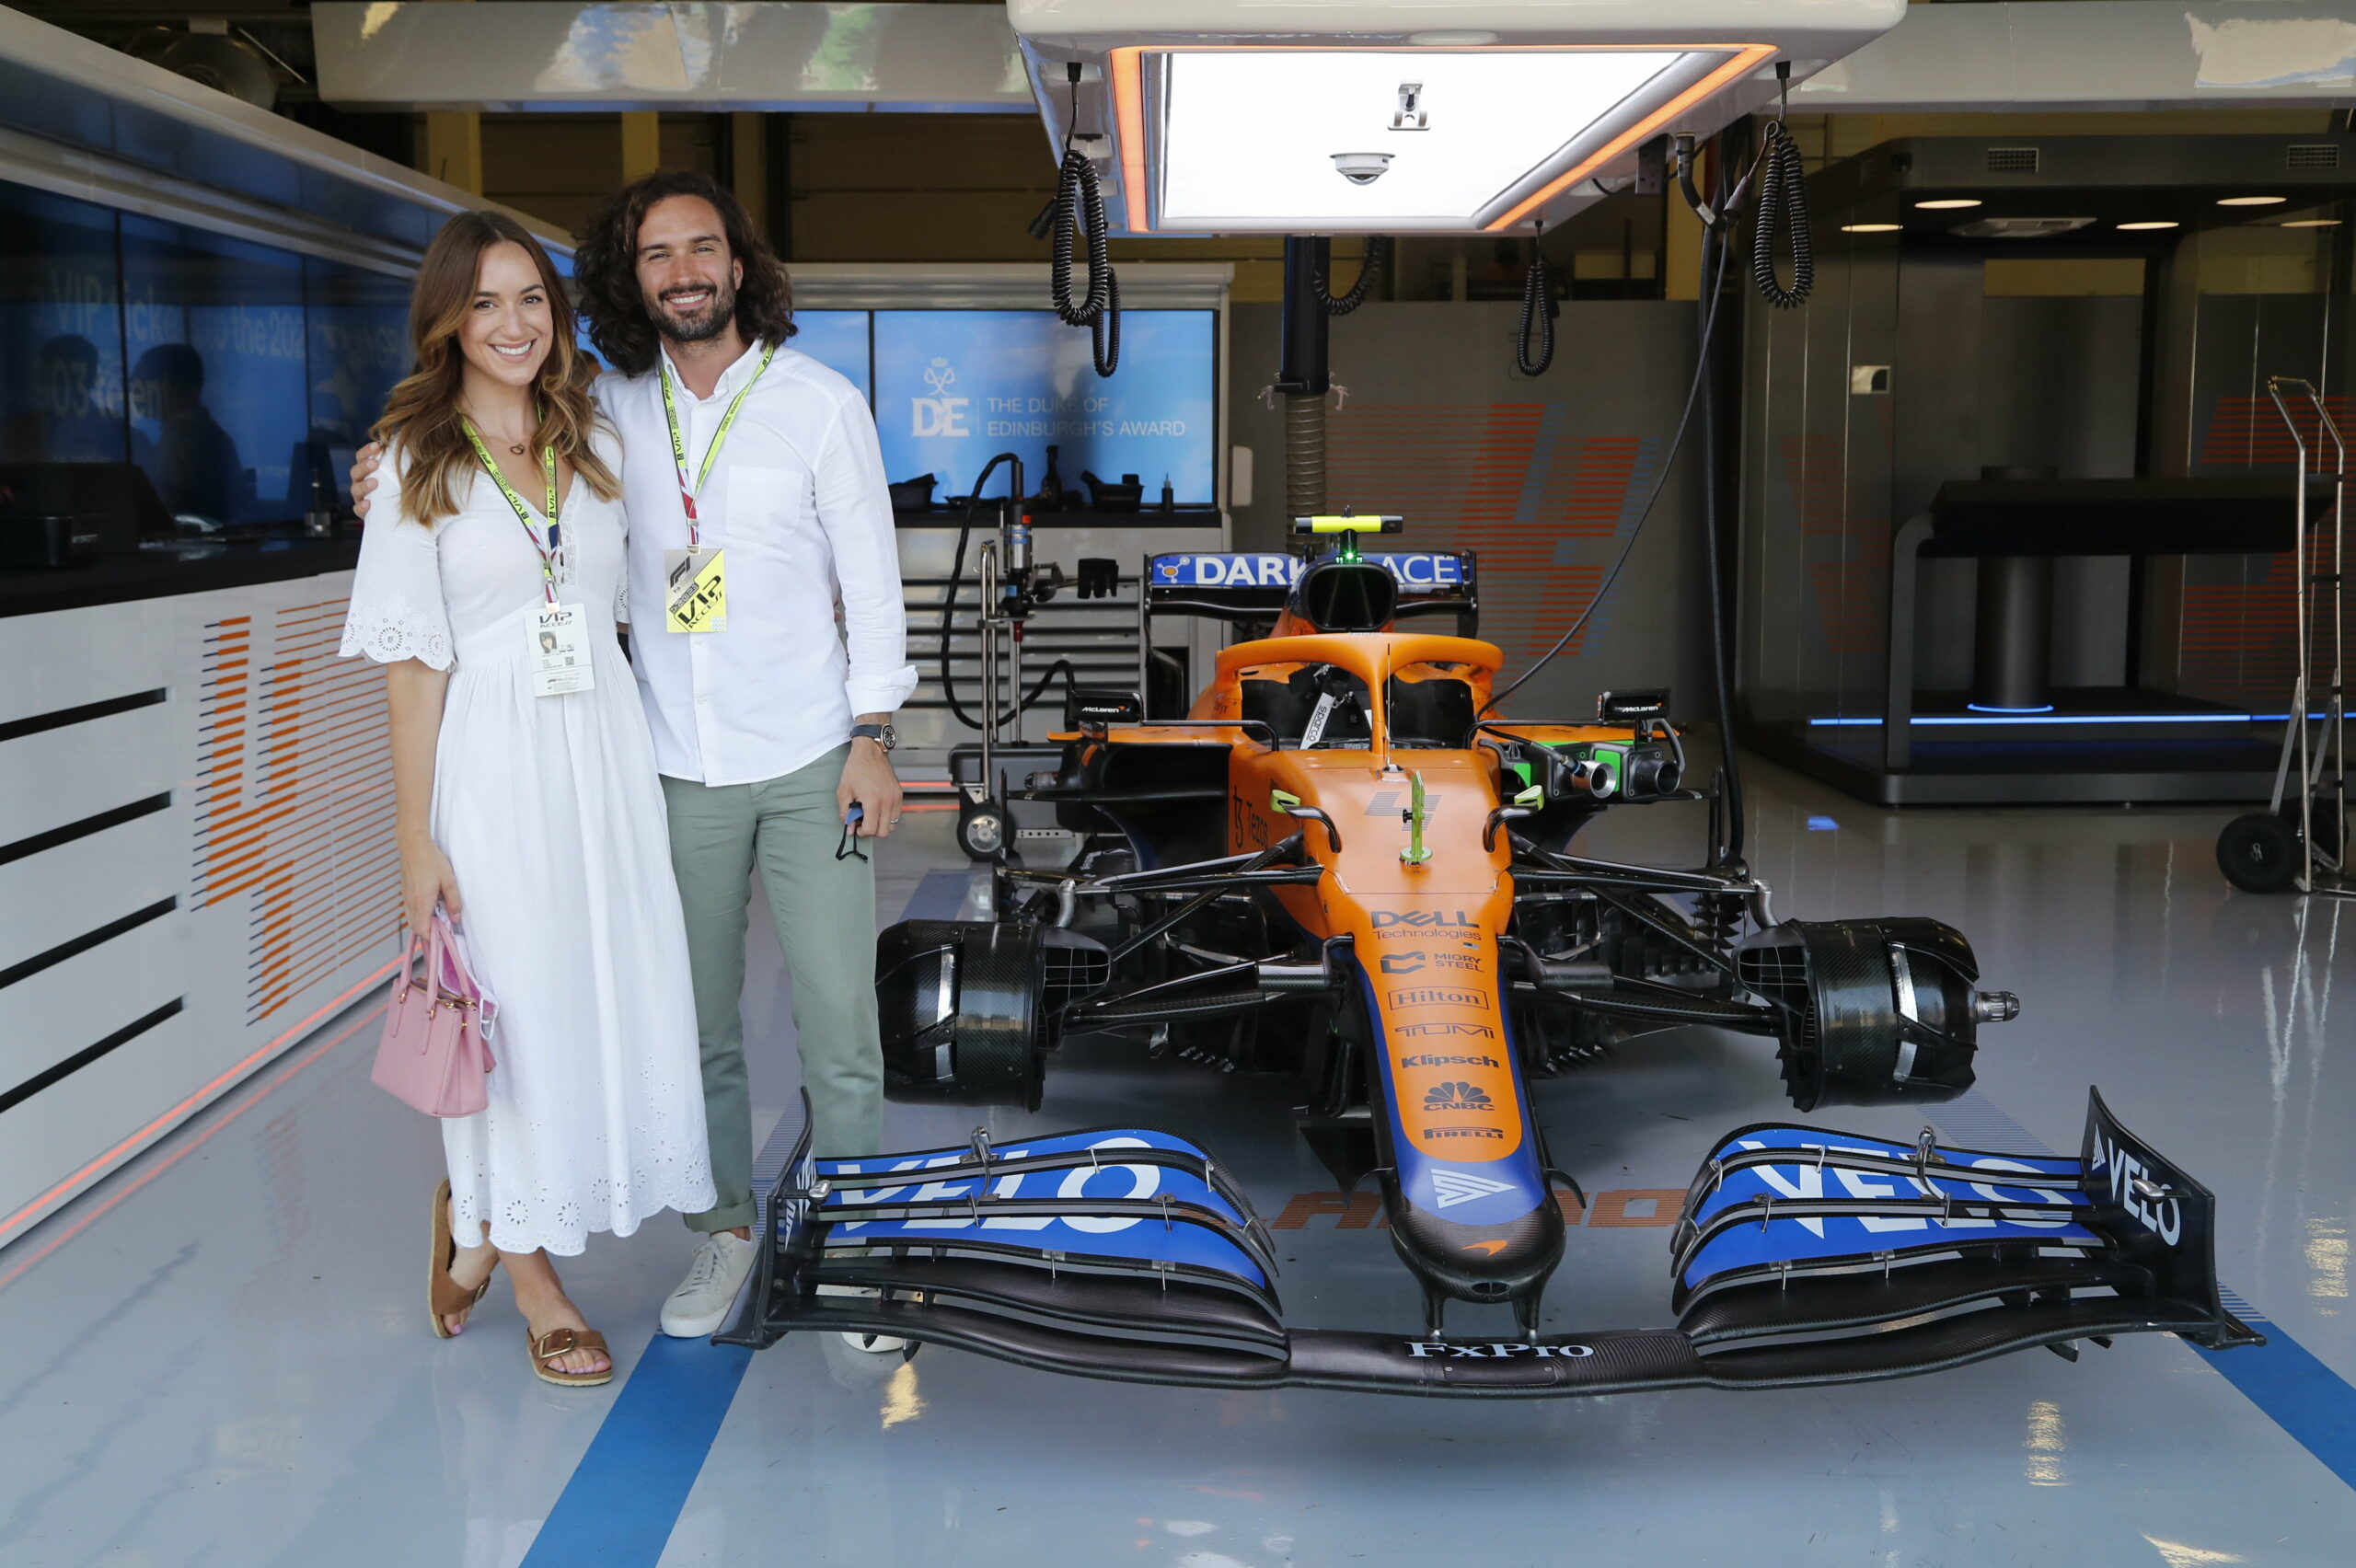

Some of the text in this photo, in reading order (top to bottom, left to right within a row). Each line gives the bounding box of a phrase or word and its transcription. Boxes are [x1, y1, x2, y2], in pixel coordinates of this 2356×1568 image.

[987, 398, 1109, 413] THE DUKE OF
[987, 421, 1186, 437] EDINBURGH'S AWARD
[1195, 554, 1459, 586] DARKACE
[677, 575, 722, 625] VIP
[538, 612, 572, 624] VIP
[1081, 706, 1120, 714] McLaren
[1620, 704, 1659, 713] McLaren
[1309, 705, 1328, 743] sparco
[1371, 910, 1481, 929] DELL
[1372, 928, 1483, 941] Technologies
[1434, 952, 1482, 964] MIORY
[1435, 961, 1484, 974] STEEL
[1398, 990, 1481, 1006] Hilton
[1402, 1054, 1500, 1069] Klipsch
[1423, 1101, 1496, 1112] CNBC
[1423, 1127, 1505, 1140] PIRELLI
[1738, 1140, 2073, 1239] VELO
[2108, 1136, 2181, 1247] VELO
[1404, 1341, 1595, 1358] FxPro
